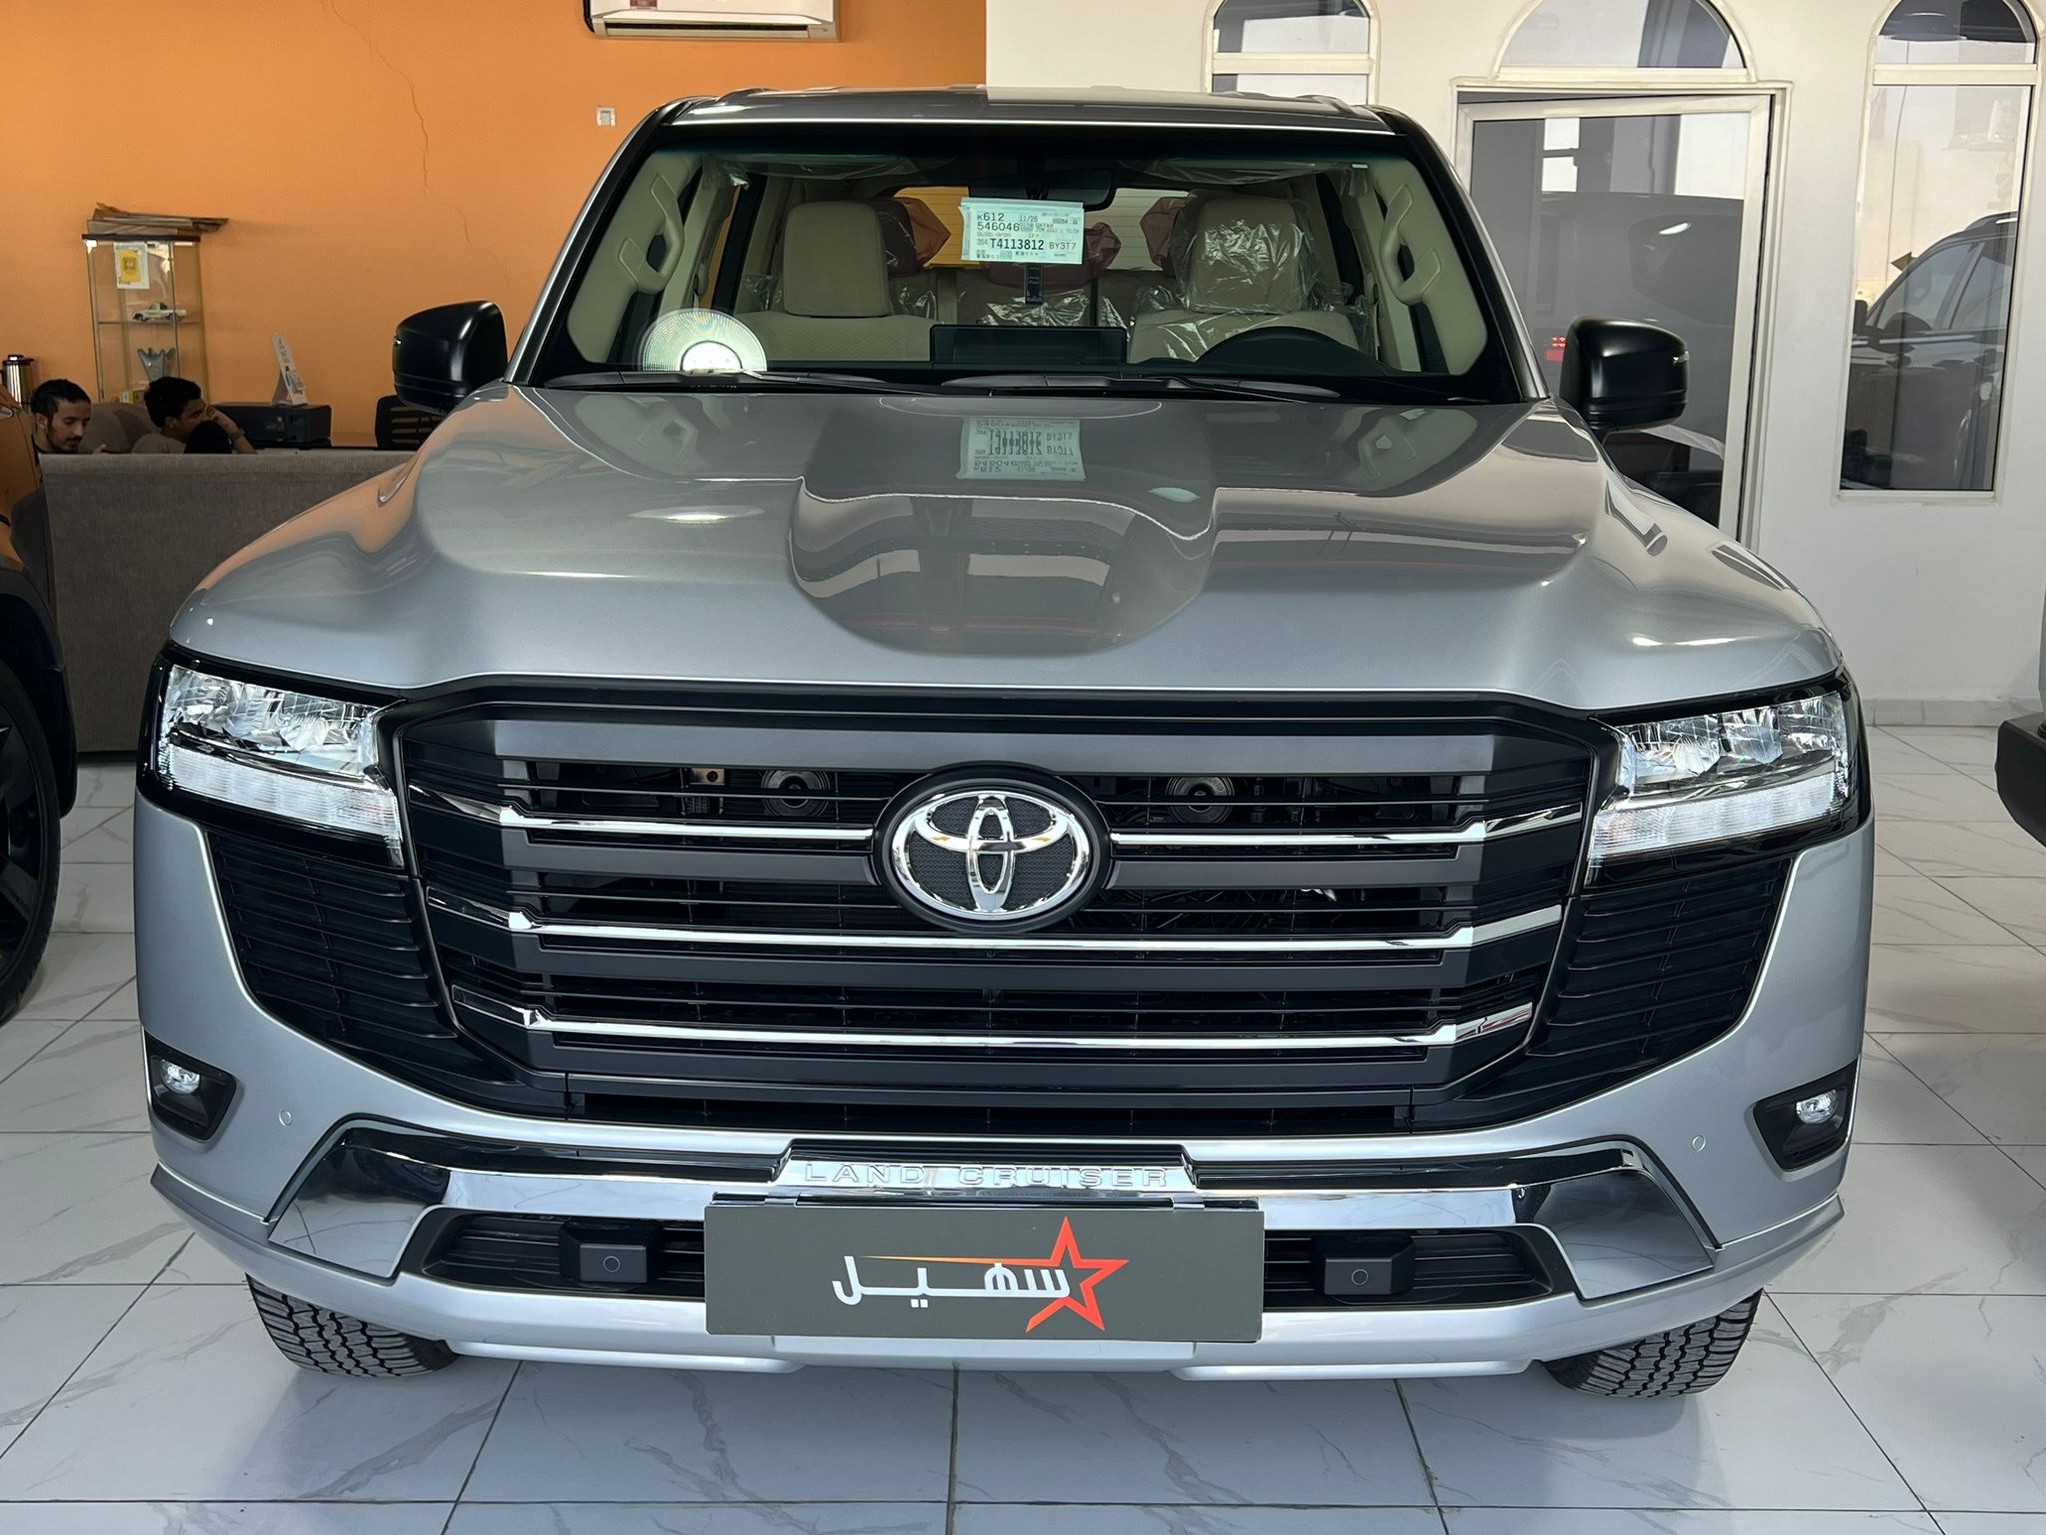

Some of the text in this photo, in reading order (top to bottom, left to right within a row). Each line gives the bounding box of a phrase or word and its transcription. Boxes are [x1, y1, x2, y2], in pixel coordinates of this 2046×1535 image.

[976, 221, 1020, 232] 546046
[989, 237, 1045, 251] T4113812
[804, 1162, 1168, 1188] LAND CRUISER
[831, 1254, 1070, 1309] سهيل
